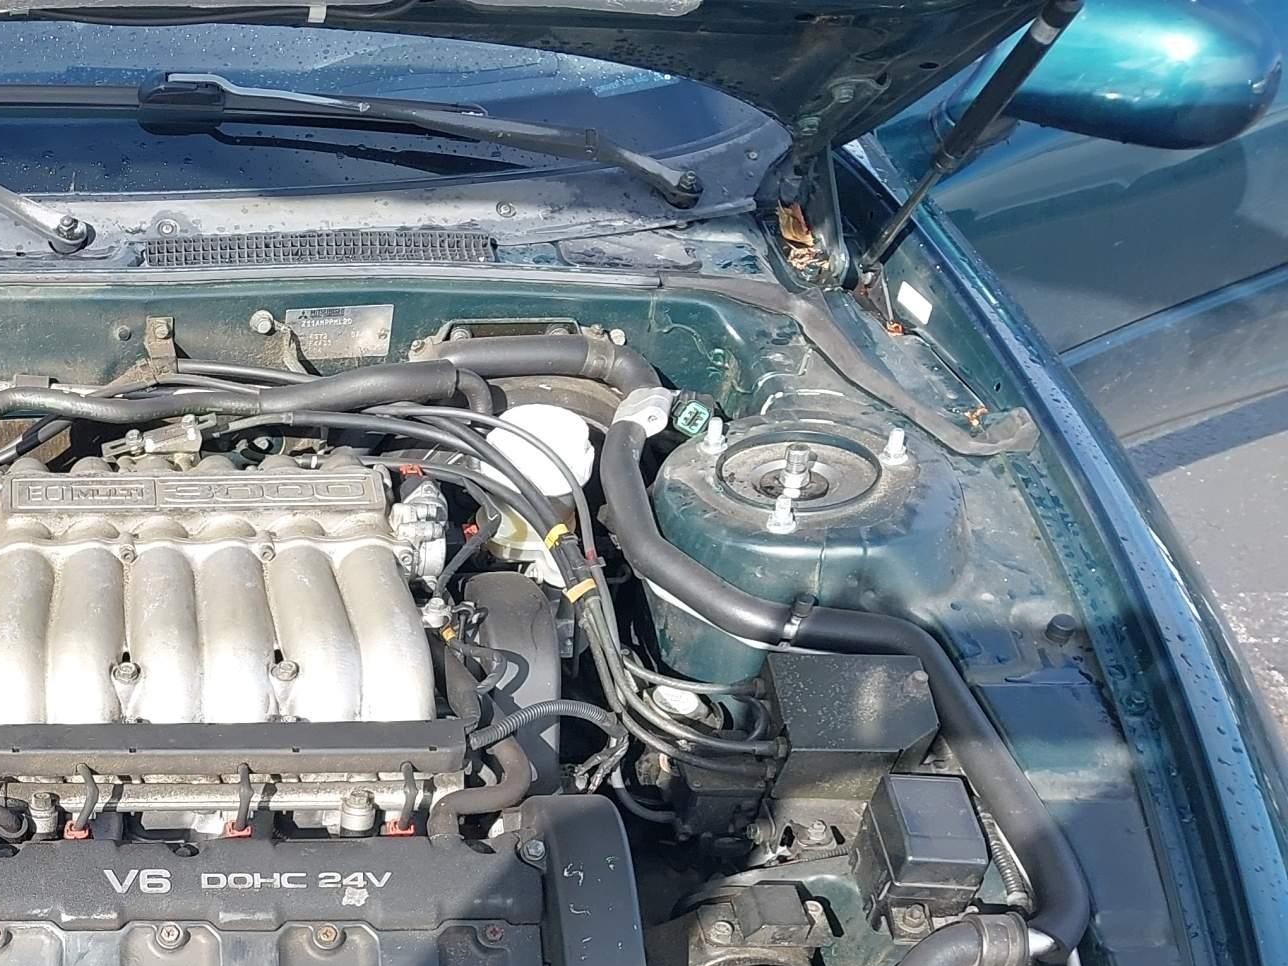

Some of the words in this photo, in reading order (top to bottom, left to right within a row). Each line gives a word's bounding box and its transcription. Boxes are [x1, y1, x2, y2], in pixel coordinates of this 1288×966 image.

[162, 482, 367, 505] 3000
[103, 868, 172, 894] V6
[201, 872, 308, 890] DOHC
[318, 871, 393, 889] 24V
